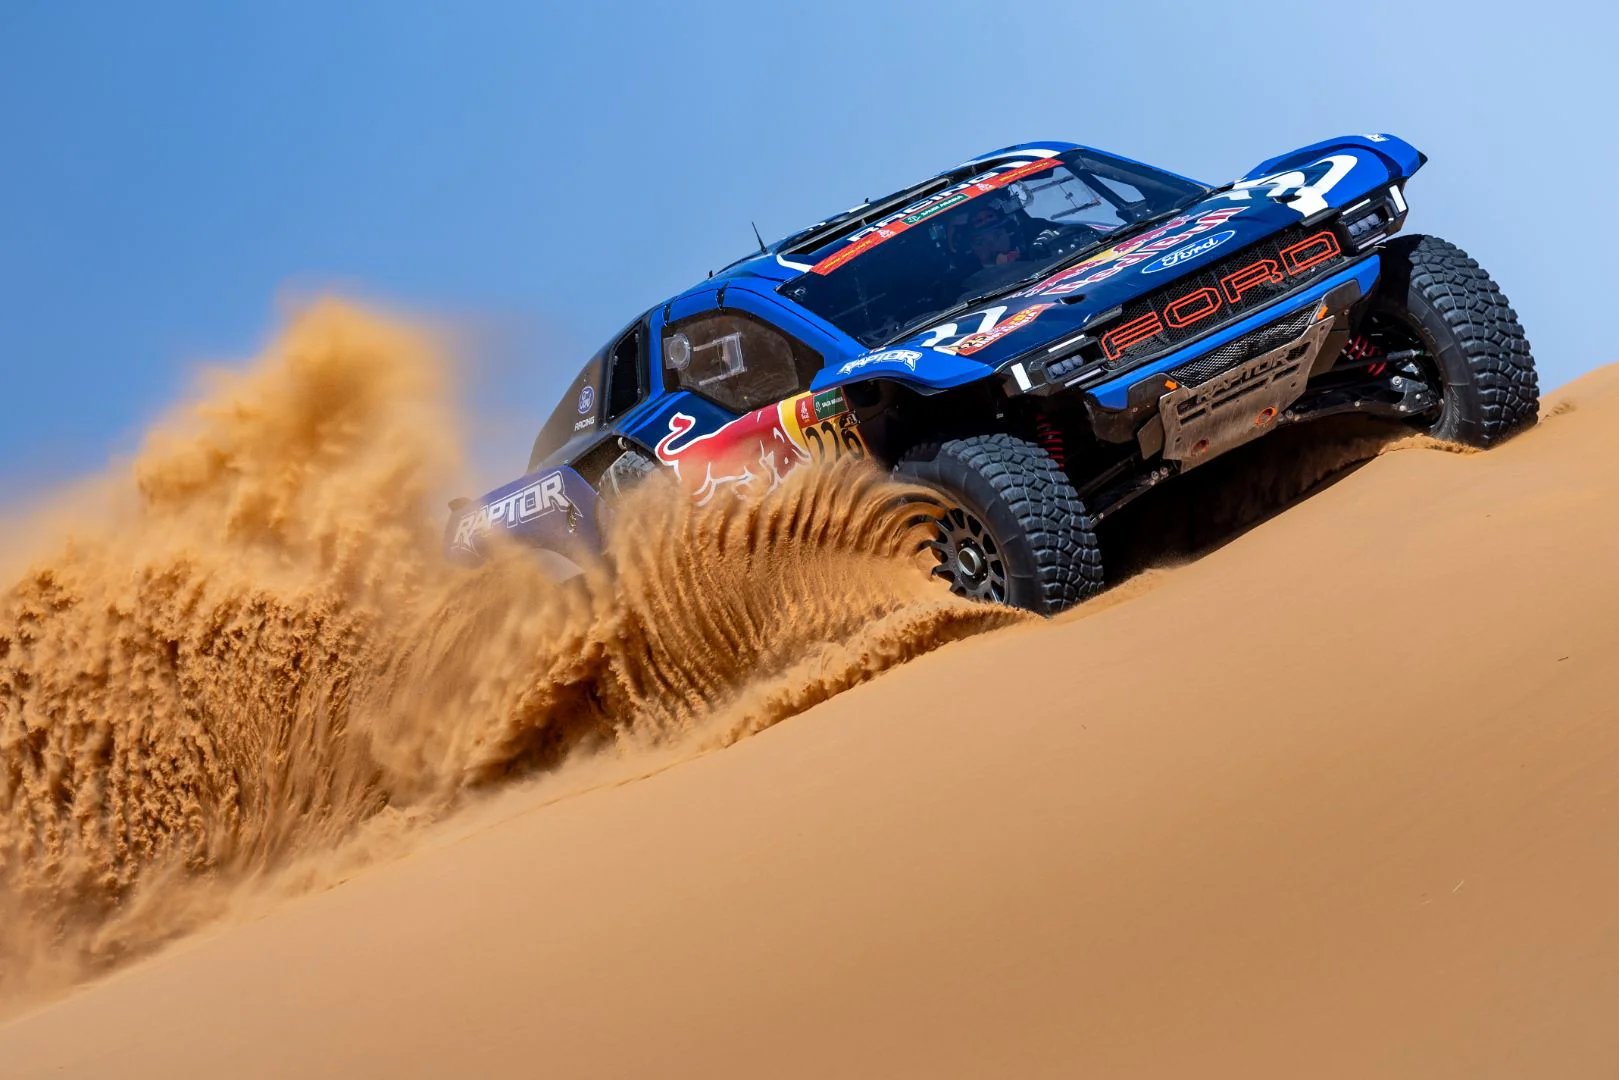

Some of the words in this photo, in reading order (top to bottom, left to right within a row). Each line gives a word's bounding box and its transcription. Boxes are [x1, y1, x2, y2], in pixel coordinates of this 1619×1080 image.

[846, 171, 999, 242] RACING
[1162, 237, 1220, 266] Ford
[1101, 231, 1341, 361] FORD
[836, 350, 923, 375] RAPTOR
[574, 415, 595, 431] RACING
[450, 471, 579, 554] RAPTOR
